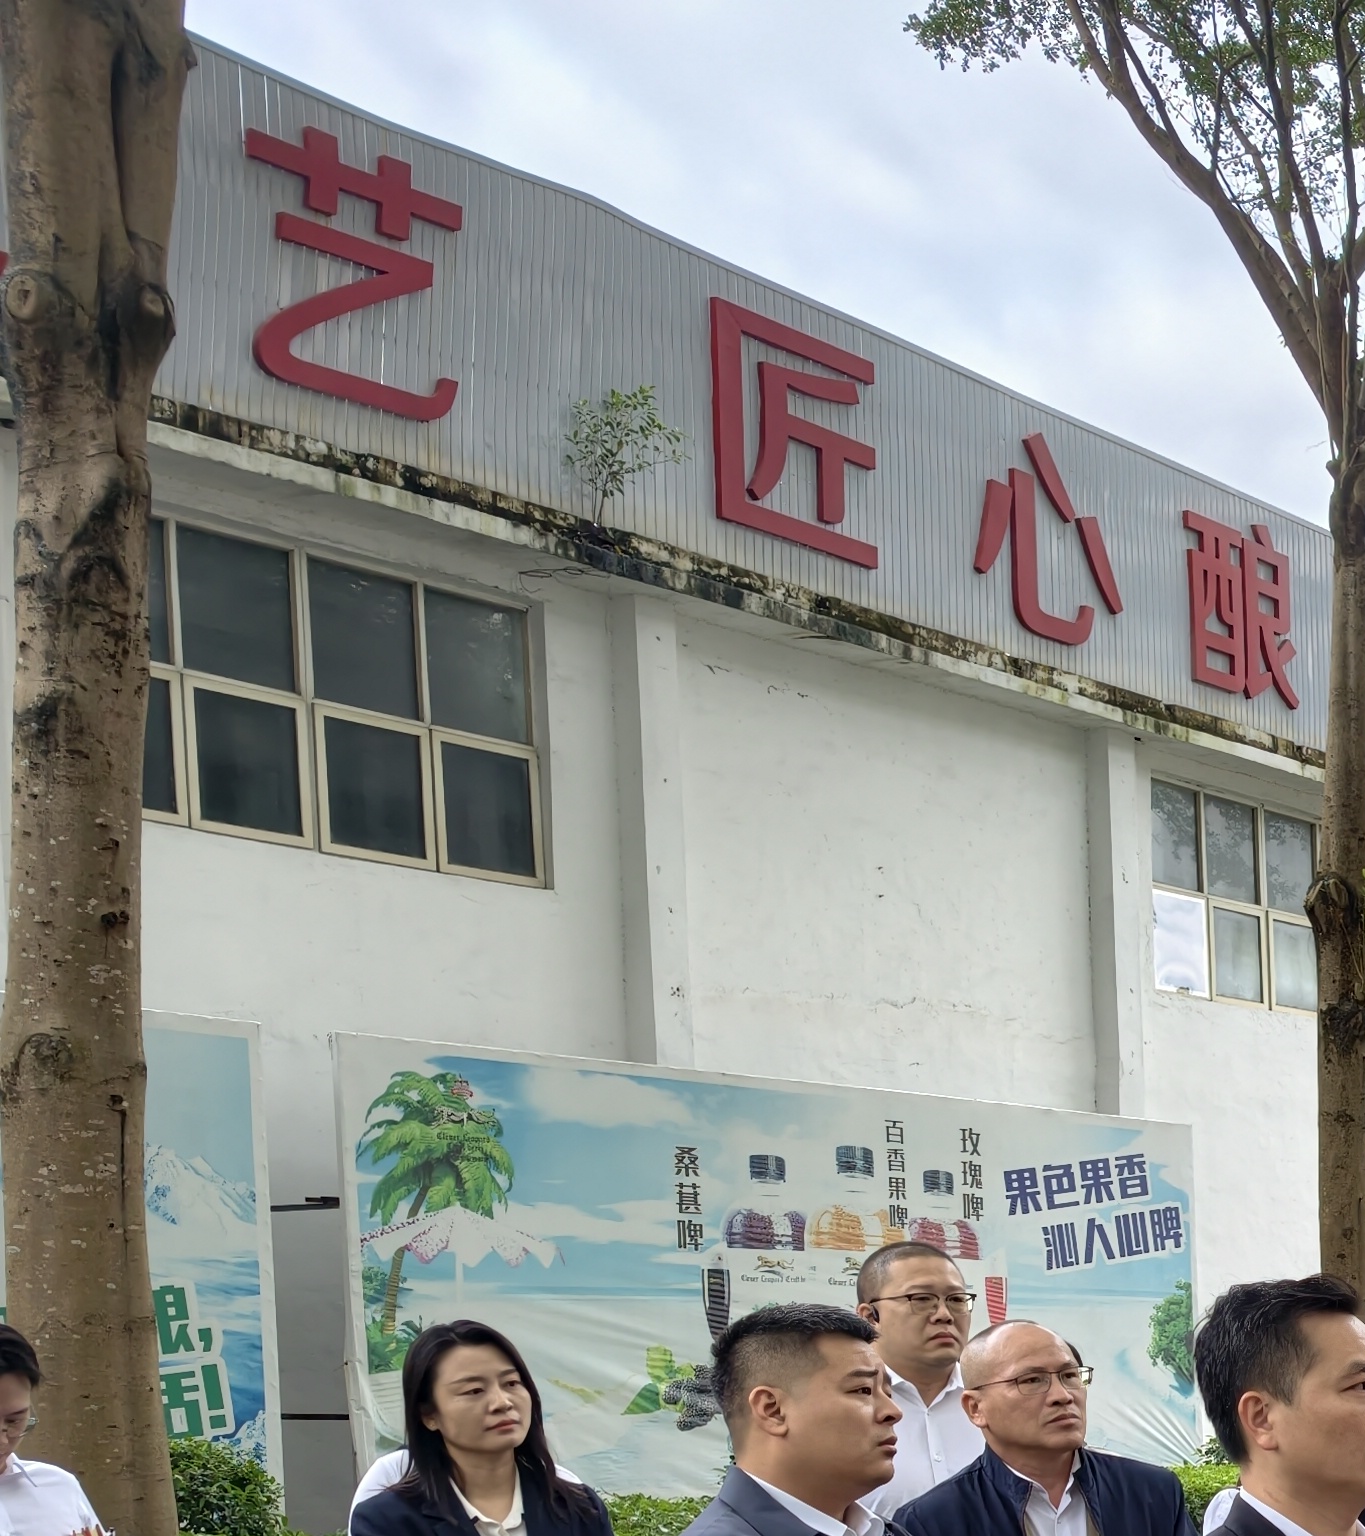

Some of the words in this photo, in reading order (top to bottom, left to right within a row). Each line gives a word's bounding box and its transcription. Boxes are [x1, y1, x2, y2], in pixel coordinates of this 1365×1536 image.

[674, 1146, 704, 1251] 桑葚啤
[885, 1119, 909, 1230] 百香果啤
[959, 1128, 984, 1223] 玫瑰啤
[1003, 1153, 1150, 1216] 果色果香
[1041, 1206, 1183, 1271] 沁人心脾
